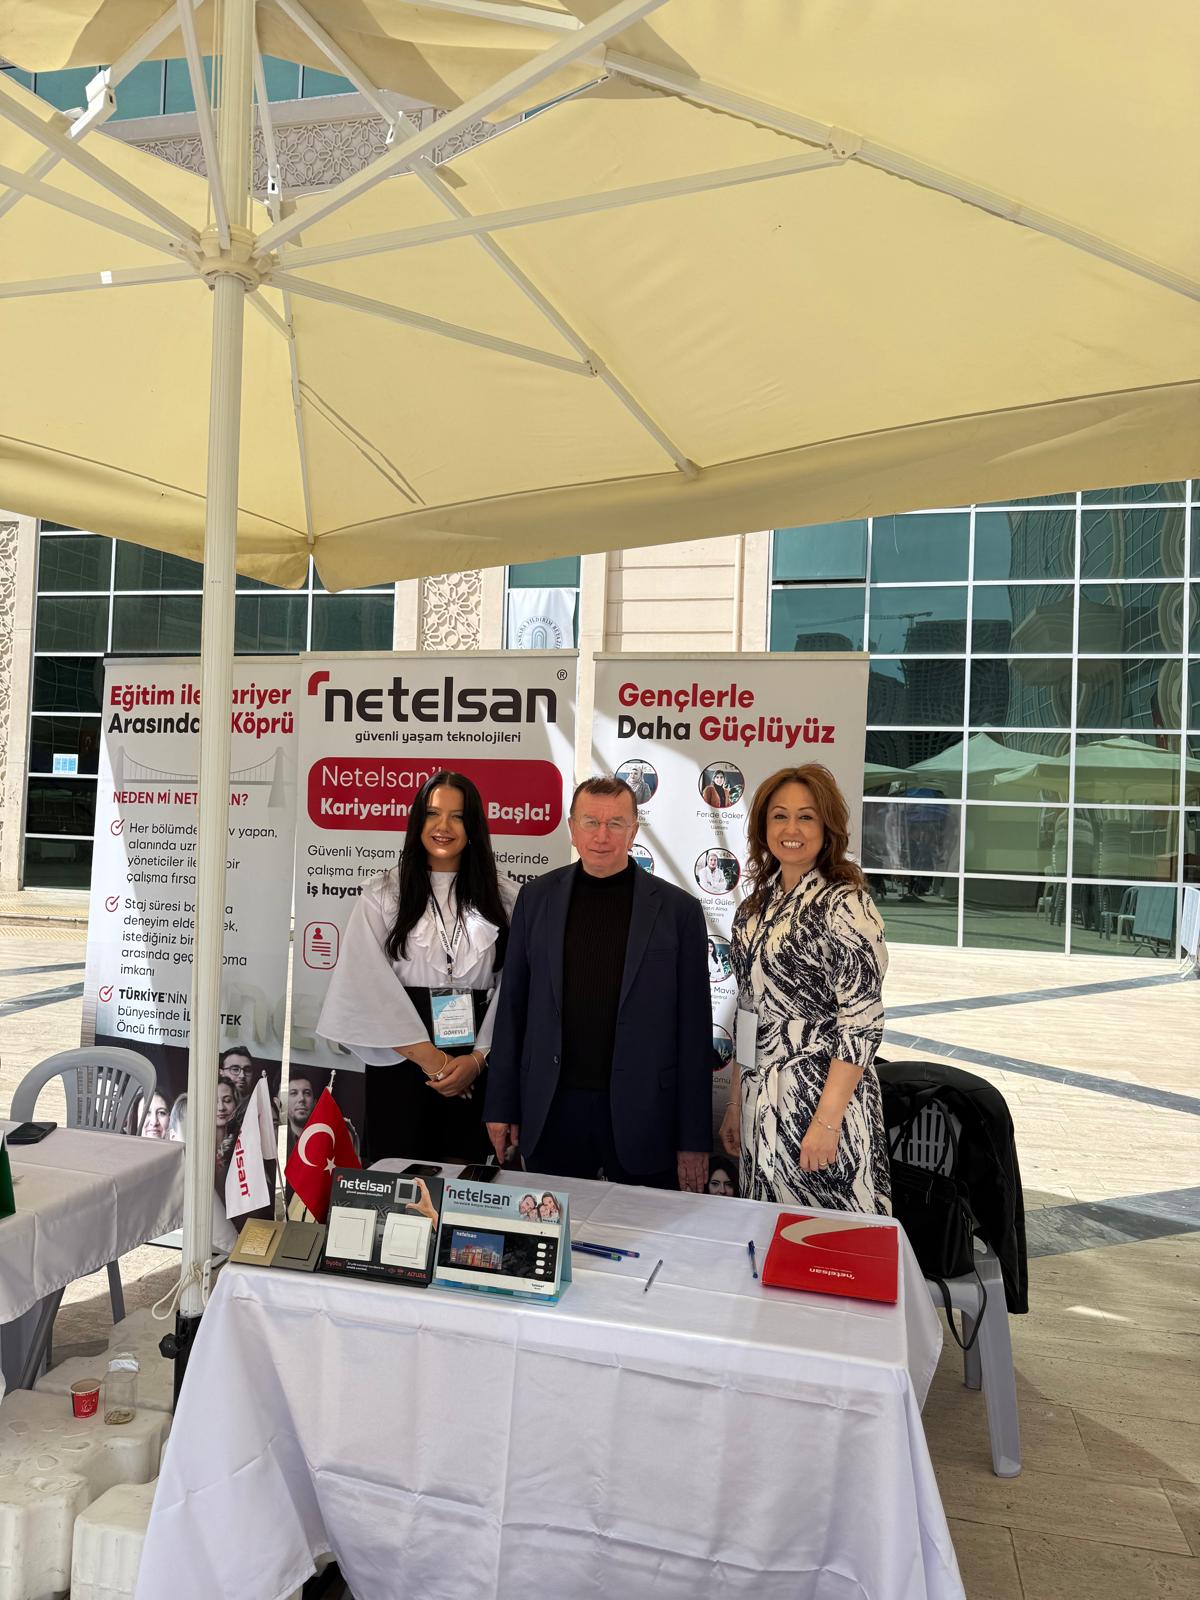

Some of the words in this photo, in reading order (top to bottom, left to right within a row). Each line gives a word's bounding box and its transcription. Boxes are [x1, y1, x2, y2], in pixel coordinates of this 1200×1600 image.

[110, 684, 175, 712] Eğitim
[231, 683, 291, 709] ariyer
[324, 677, 557, 723] netelsan
[618, 682, 755, 713] Gençlerle
[231, 712, 294, 739] Köprü
[617, 715, 691, 741] Daha
[699, 716, 836, 749] Güçlüyüz
[355, 730, 399, 744] güvenli
[402, 732, 443, 744] yaşam
[447, 730, 521, 744] teknolojileri
[322, 765, 444, 788] Netelsan'
[113, 791, 154, 805] NEDEN
[157, 789, 171, 805] Mİ
[487, 802, 551, 825] Başla!
[129, 823, 149, 834] Her
[238, 828, 278, 840] yapan,
[128, 840, 176, 851] alanında
[307, 844, 352, 857] Güvenli
[355, 847, 395, 860] Yaşam
[127, 856, 184, 873] yöneticiler
[307, 865, 354, 877] çalışma
[126, 872, 169, 884] çalışma
[306, 881, 319, 898] iş
[322, 883, 363, 899] hayat
[124, 899, 147, 912] Staj
[149, 900, 181, 911] süresi
[123, 916, 169, 931] deneyim
[122, 931, 176, 946] istediğiniz
[121, 949, 170, 961] arasında
[120, 965, 155, 977] imkanı
[119, 987, 187, 1005] TÜRKİYE'NİN
[118, 1005, 180, 1021] bünyesinde
[220, 1013, 242, 1026] TEK
[116, 1020, 145, 1034] Öncü
[340, 1178, 391, 1194] netelsan
[448, 1188, 511, 1206] netelsan
[809, 1268, 855, 1280] netelsan
